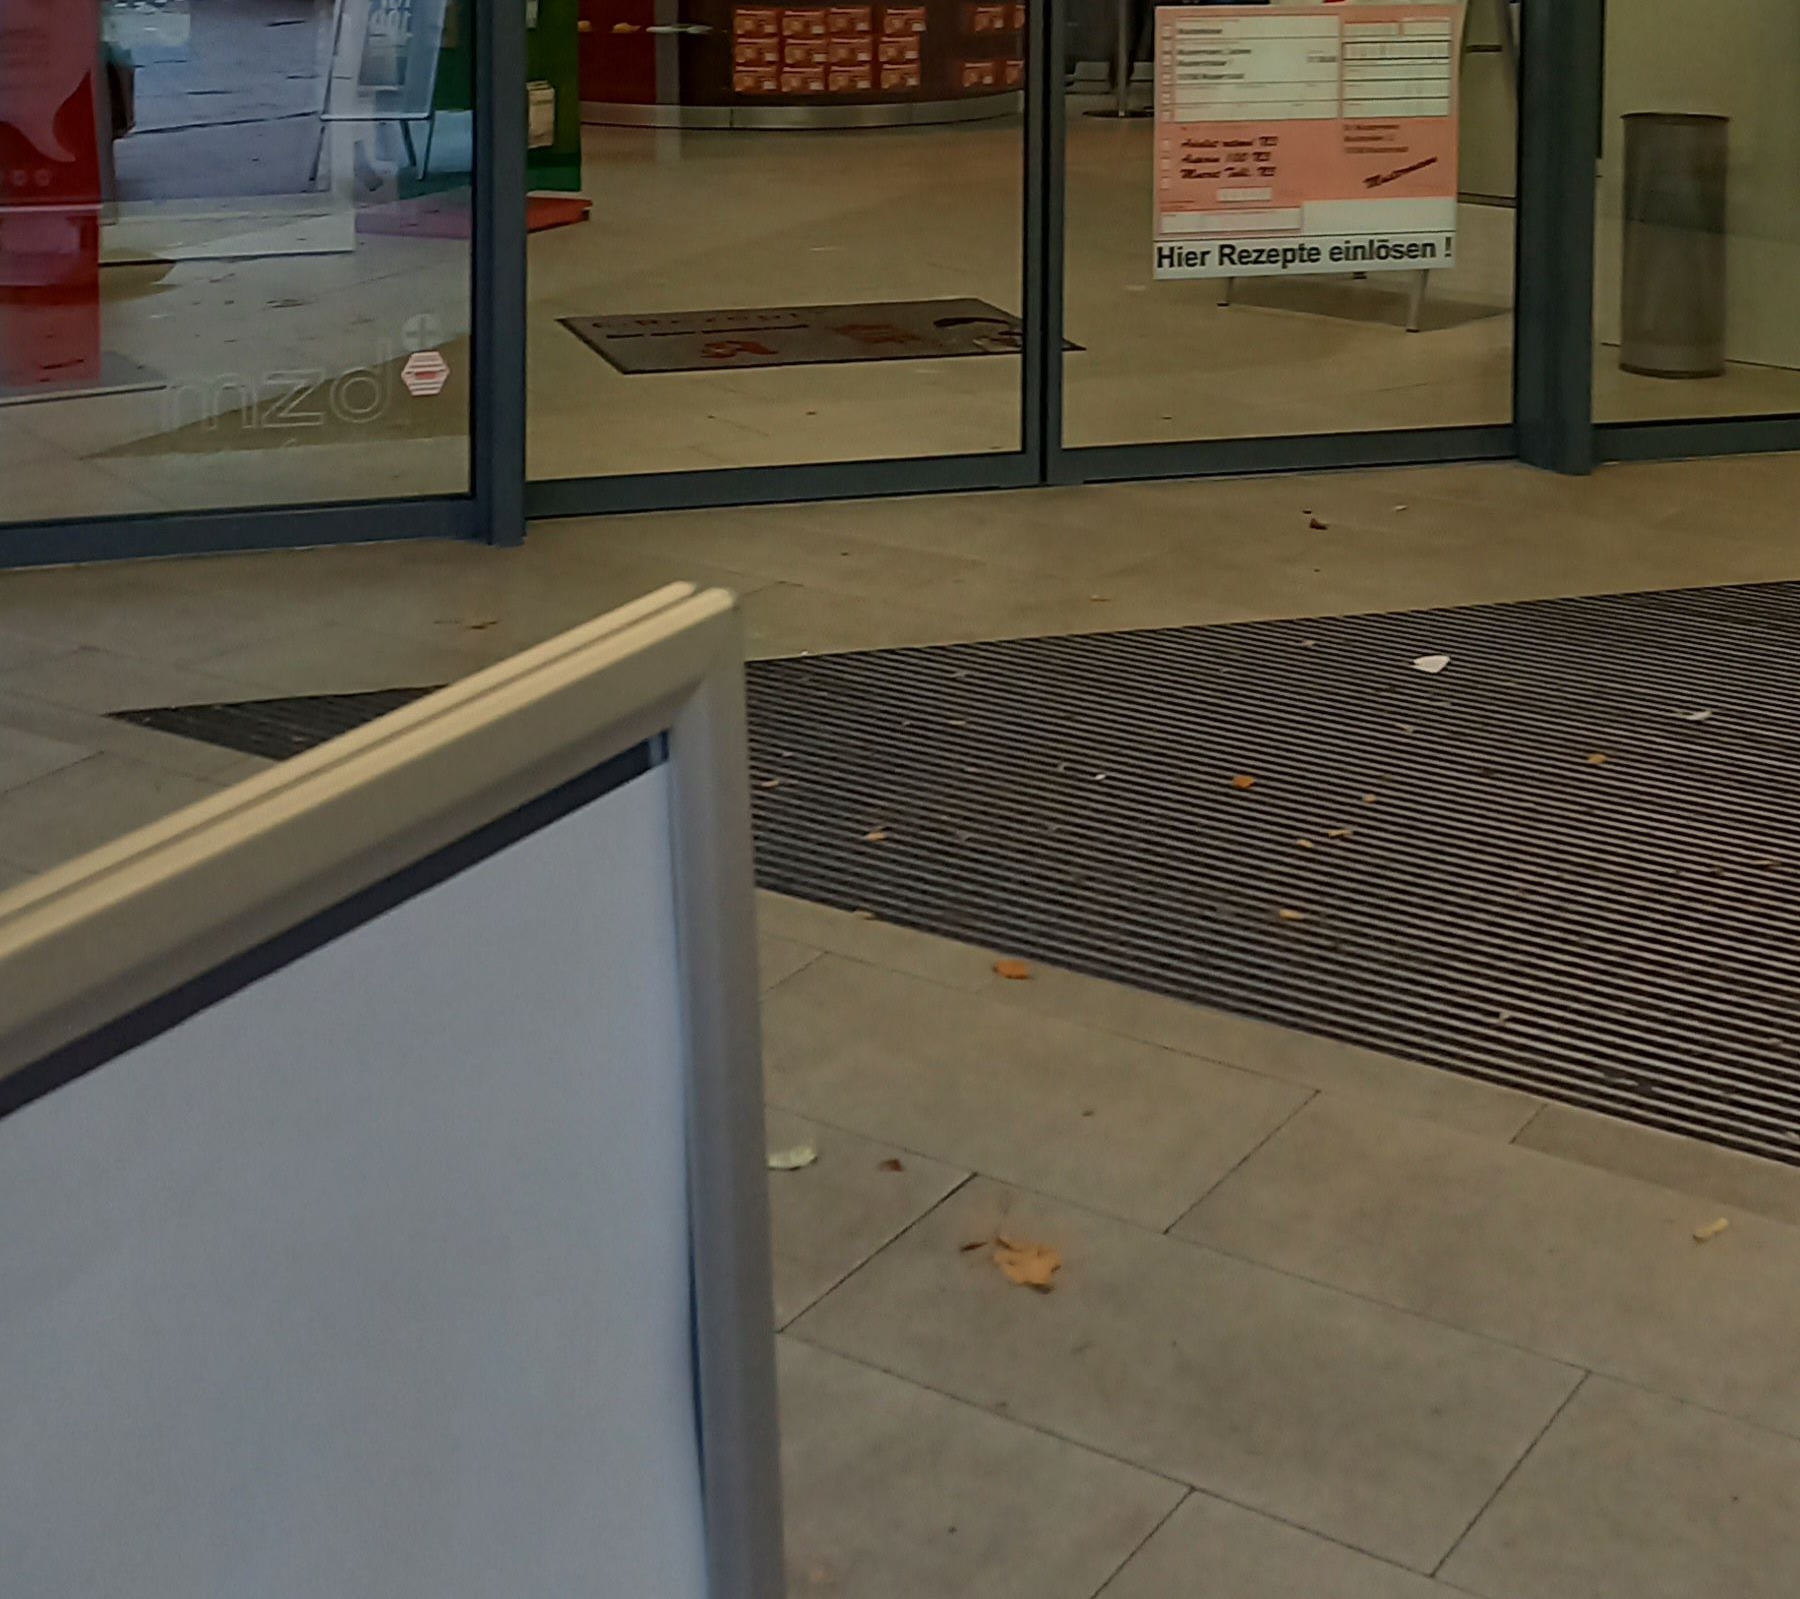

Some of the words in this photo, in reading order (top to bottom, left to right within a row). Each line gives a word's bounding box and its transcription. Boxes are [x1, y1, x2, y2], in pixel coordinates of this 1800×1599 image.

[1156, 244, 1211, 269] Hier
[1217, 242, 1321, 270] Rezepte
[1328, 238, 1437, 263] einlösen
[1444, 237, 1453, 258] !
